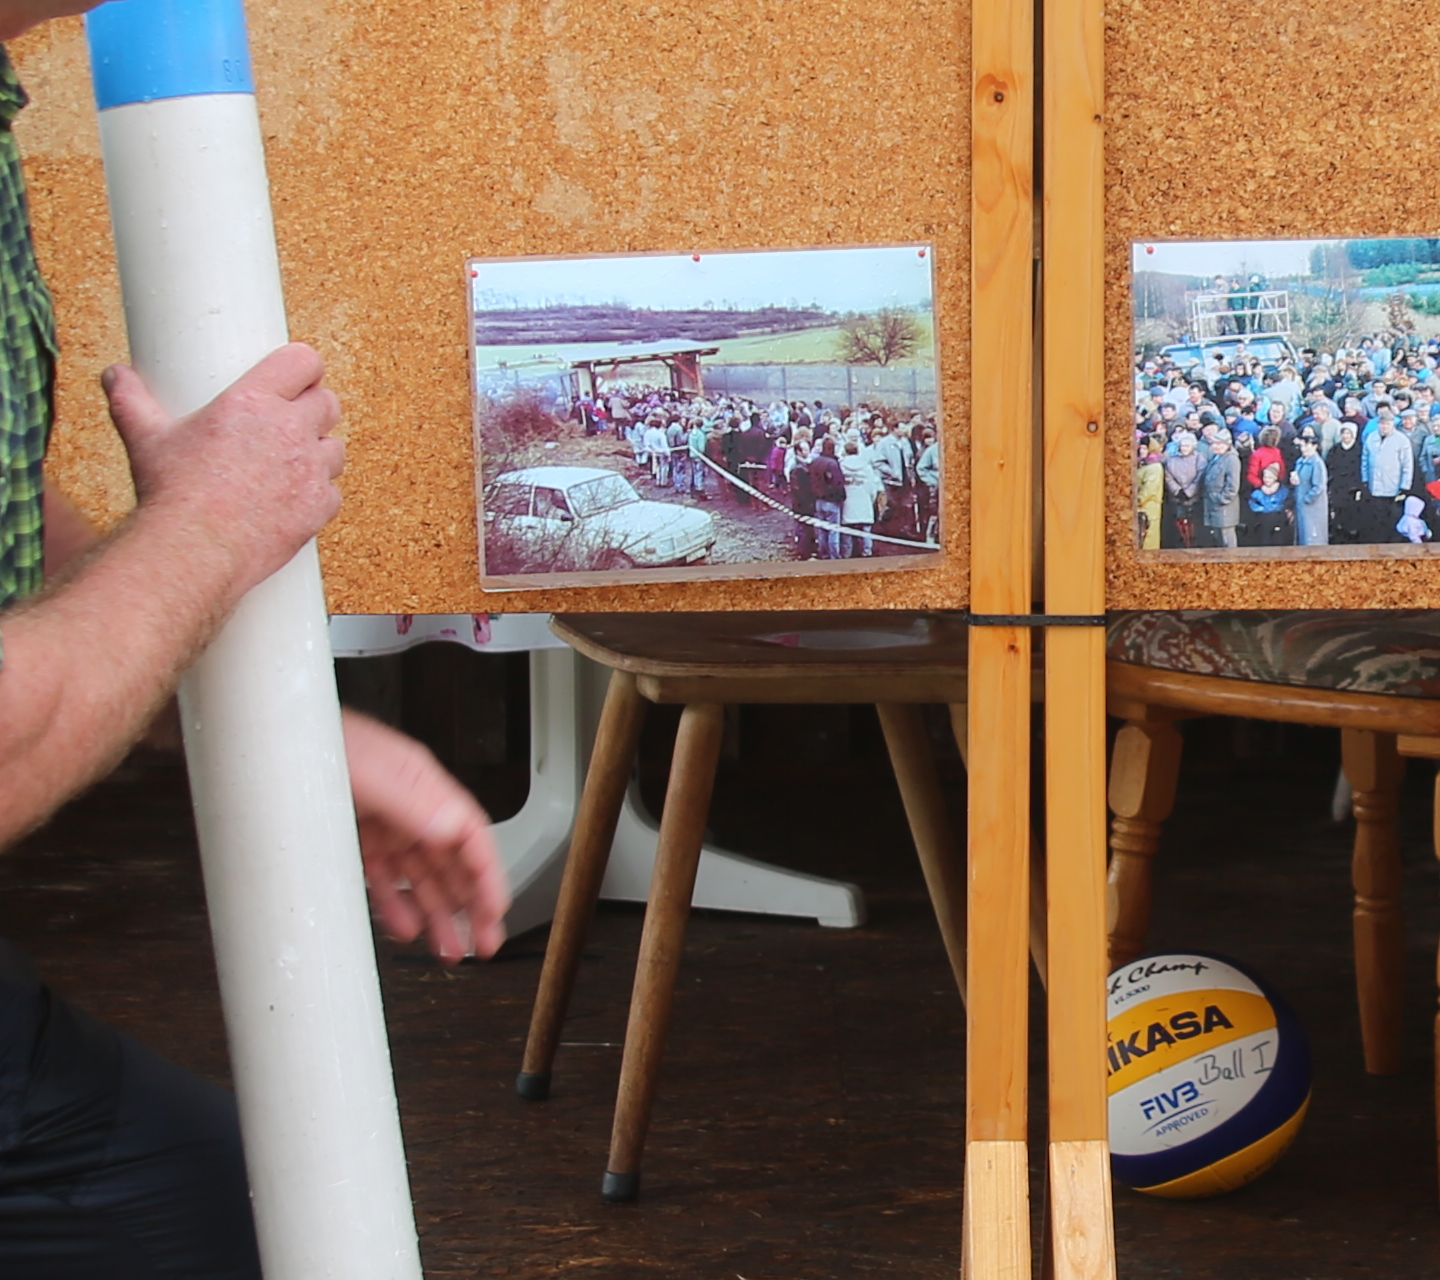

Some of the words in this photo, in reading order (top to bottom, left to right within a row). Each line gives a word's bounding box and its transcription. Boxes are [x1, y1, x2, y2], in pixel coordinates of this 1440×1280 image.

[1128, 961, 1209, 984] Champ
[1108, 1005, 1234, 1077] IKASA
[1140, 1081, 1199, 1120] FIVB
[1155, 1108, 1209, 1137] APPROVED
